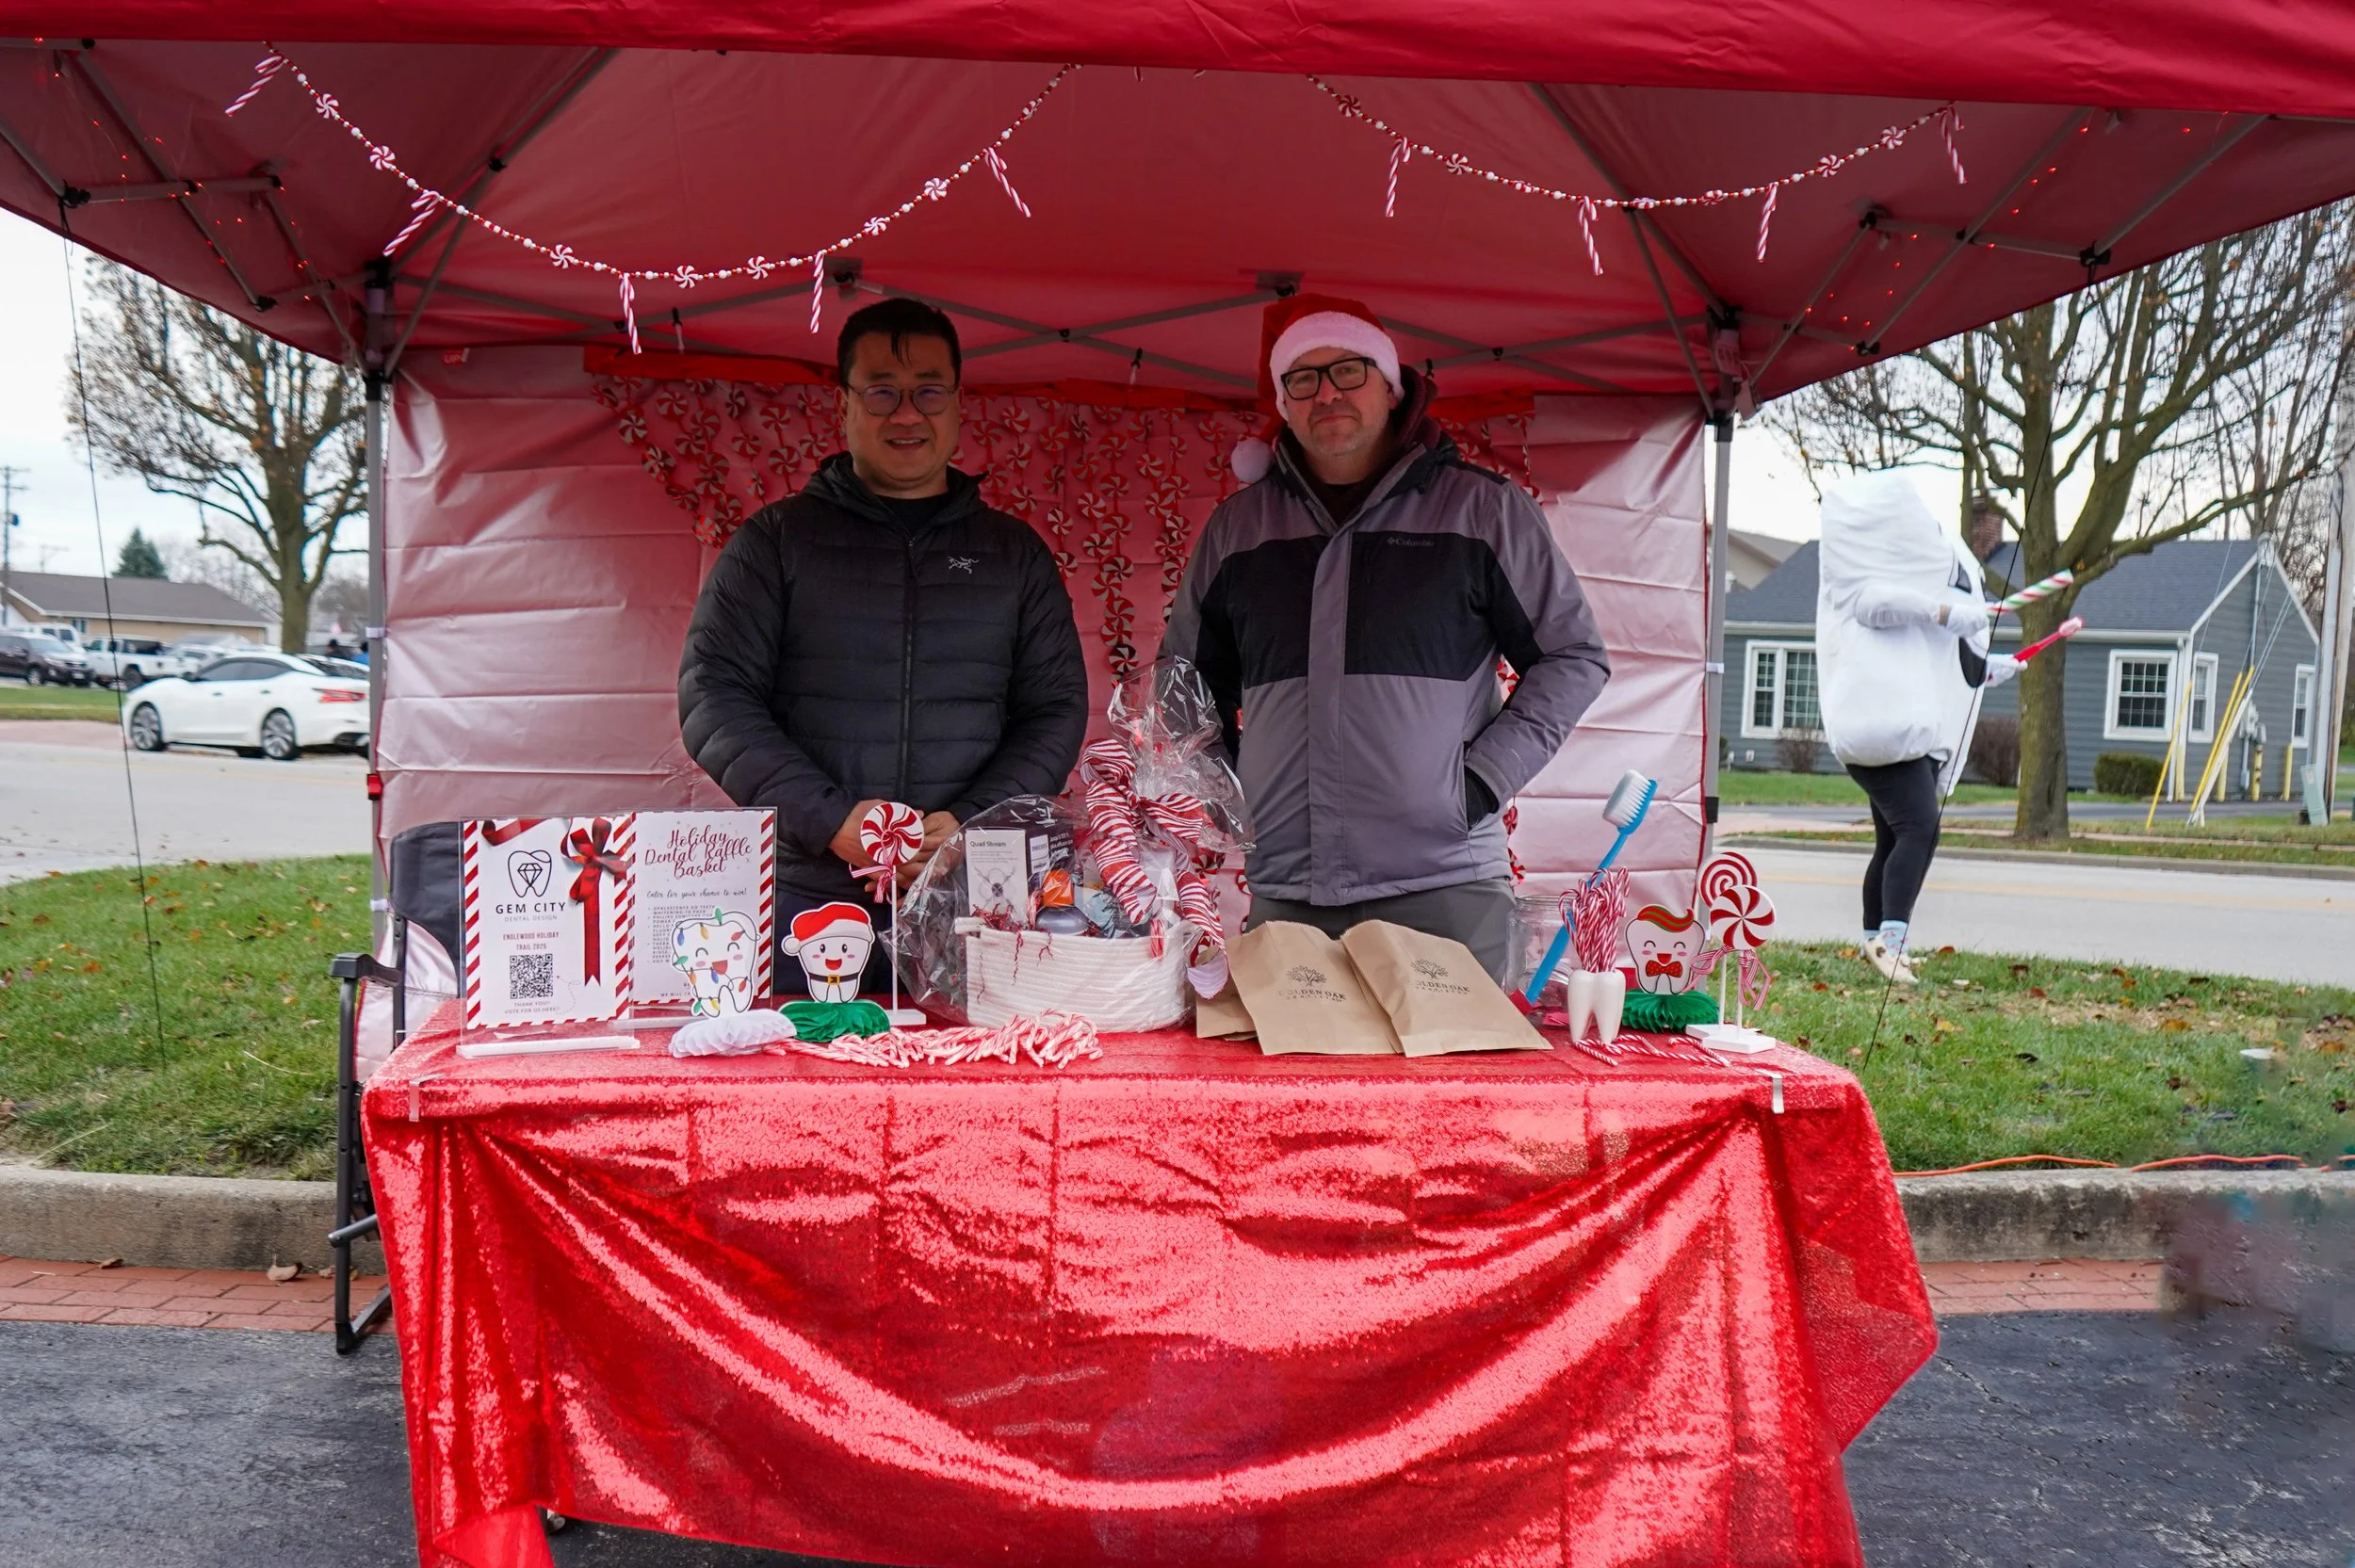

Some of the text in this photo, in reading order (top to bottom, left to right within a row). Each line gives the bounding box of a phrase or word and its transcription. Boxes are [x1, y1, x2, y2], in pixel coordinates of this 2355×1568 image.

[1395, 538, 1435, 547] Columbia
[667, 824, 728, 849] Holiday
[644, 837, 753, 865] Dental Raffle
[674, 857, 726, 880] Basket
[646, 889, 663, 898] Enter
[666, 889, 677, 898] for
[681, 891, 696, 899] your
[699, 887, 720, 897] chance
[723, 888, 732, 897] to
[495, 902, 565, 913] GEM CITY
[1449, 984, 1470, 993] OAK
[1324, 991, 1347, 1001] OAK
